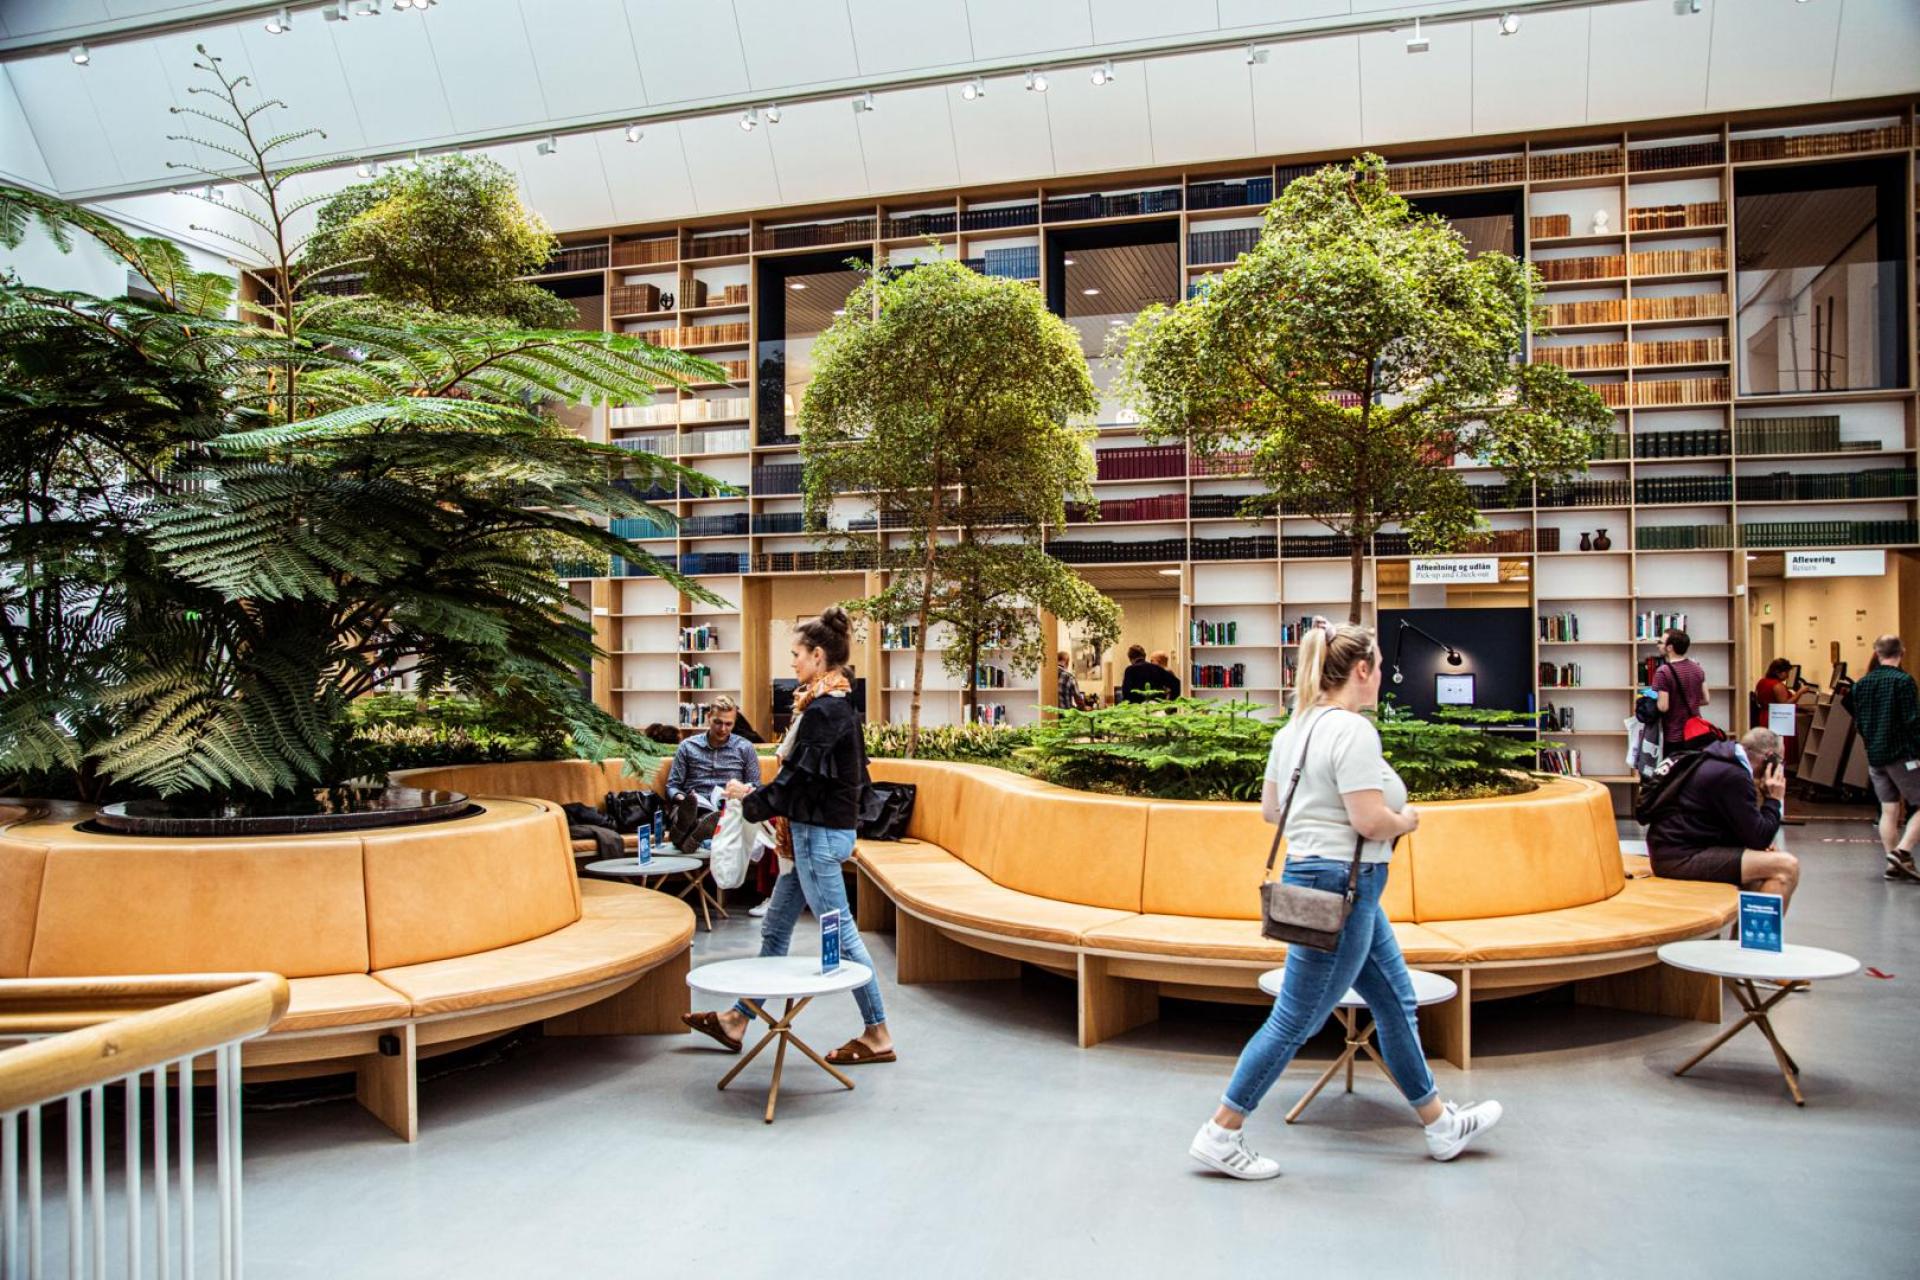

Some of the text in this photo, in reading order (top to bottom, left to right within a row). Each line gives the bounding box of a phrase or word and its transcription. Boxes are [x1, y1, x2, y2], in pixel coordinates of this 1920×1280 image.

[1792, 555, 1836, 564] Aflevering
[1416, 563, 1457, 571] Afhentning
[1469, 562, 1491, 570] udlån
